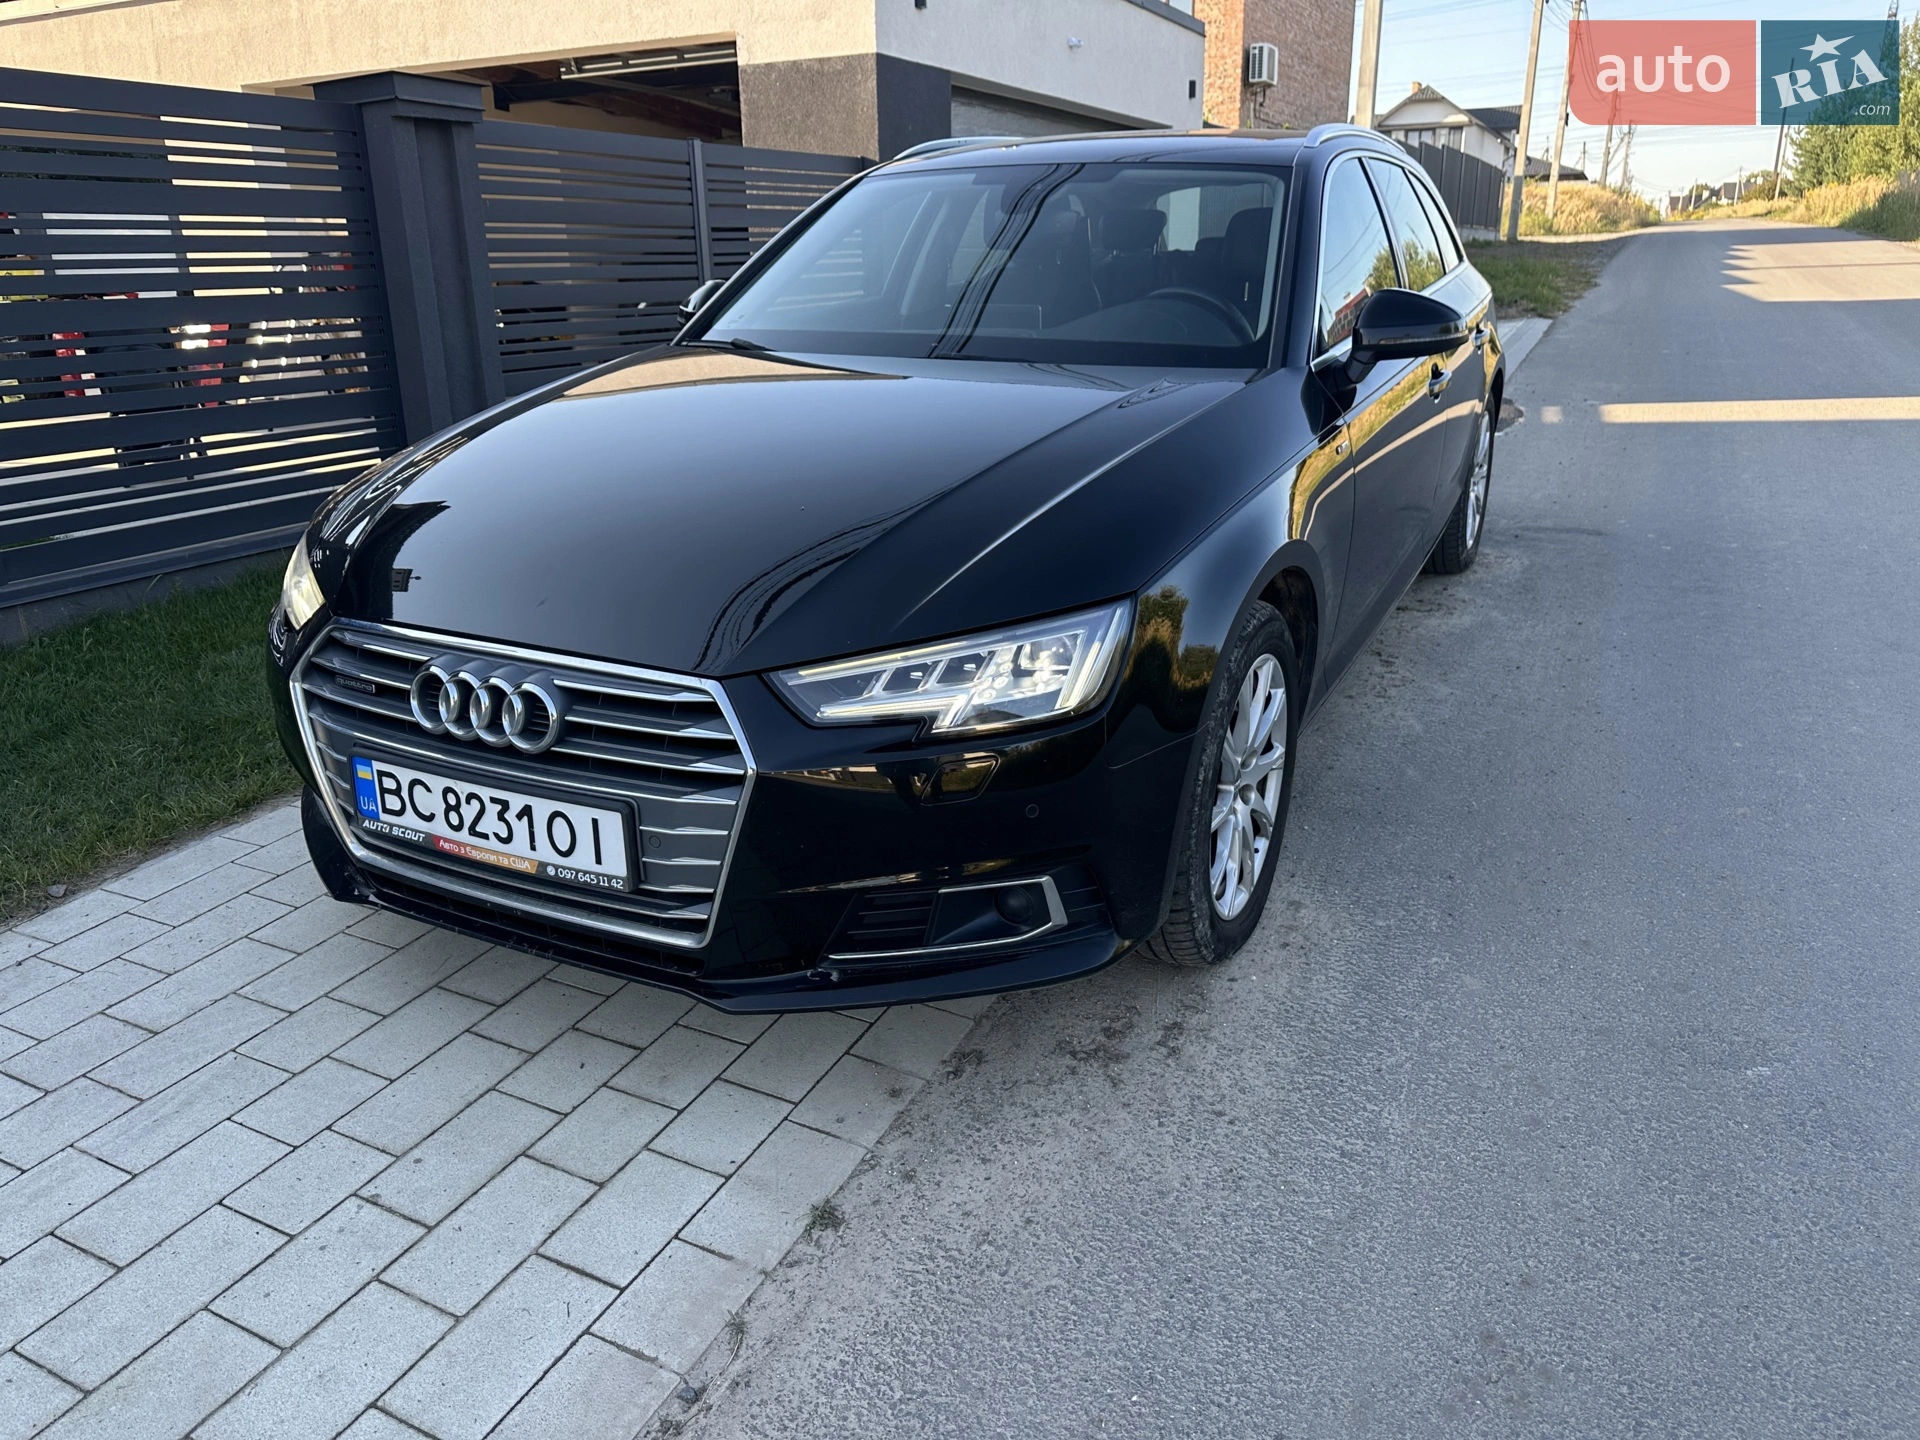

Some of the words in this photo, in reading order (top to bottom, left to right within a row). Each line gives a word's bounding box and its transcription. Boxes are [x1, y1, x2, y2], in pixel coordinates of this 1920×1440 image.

[336, 677, 373, 691] quattro
[360, 796, 378, 812] UA
[362, 819, 389, 833] AUTO
[391, 826, 425, 842] SCOUT
[439, 839, 459, 852] Авто
[466, 846, 497, 863] Європи
[498, 855, 508, 865] та
[510, 857, 531, 870] США
[557, 867, 576, 880] 097
[577, 873, 597, 885] 645
[599, 876, 609, 886] 11
[610, 878, 623, 889] 42
